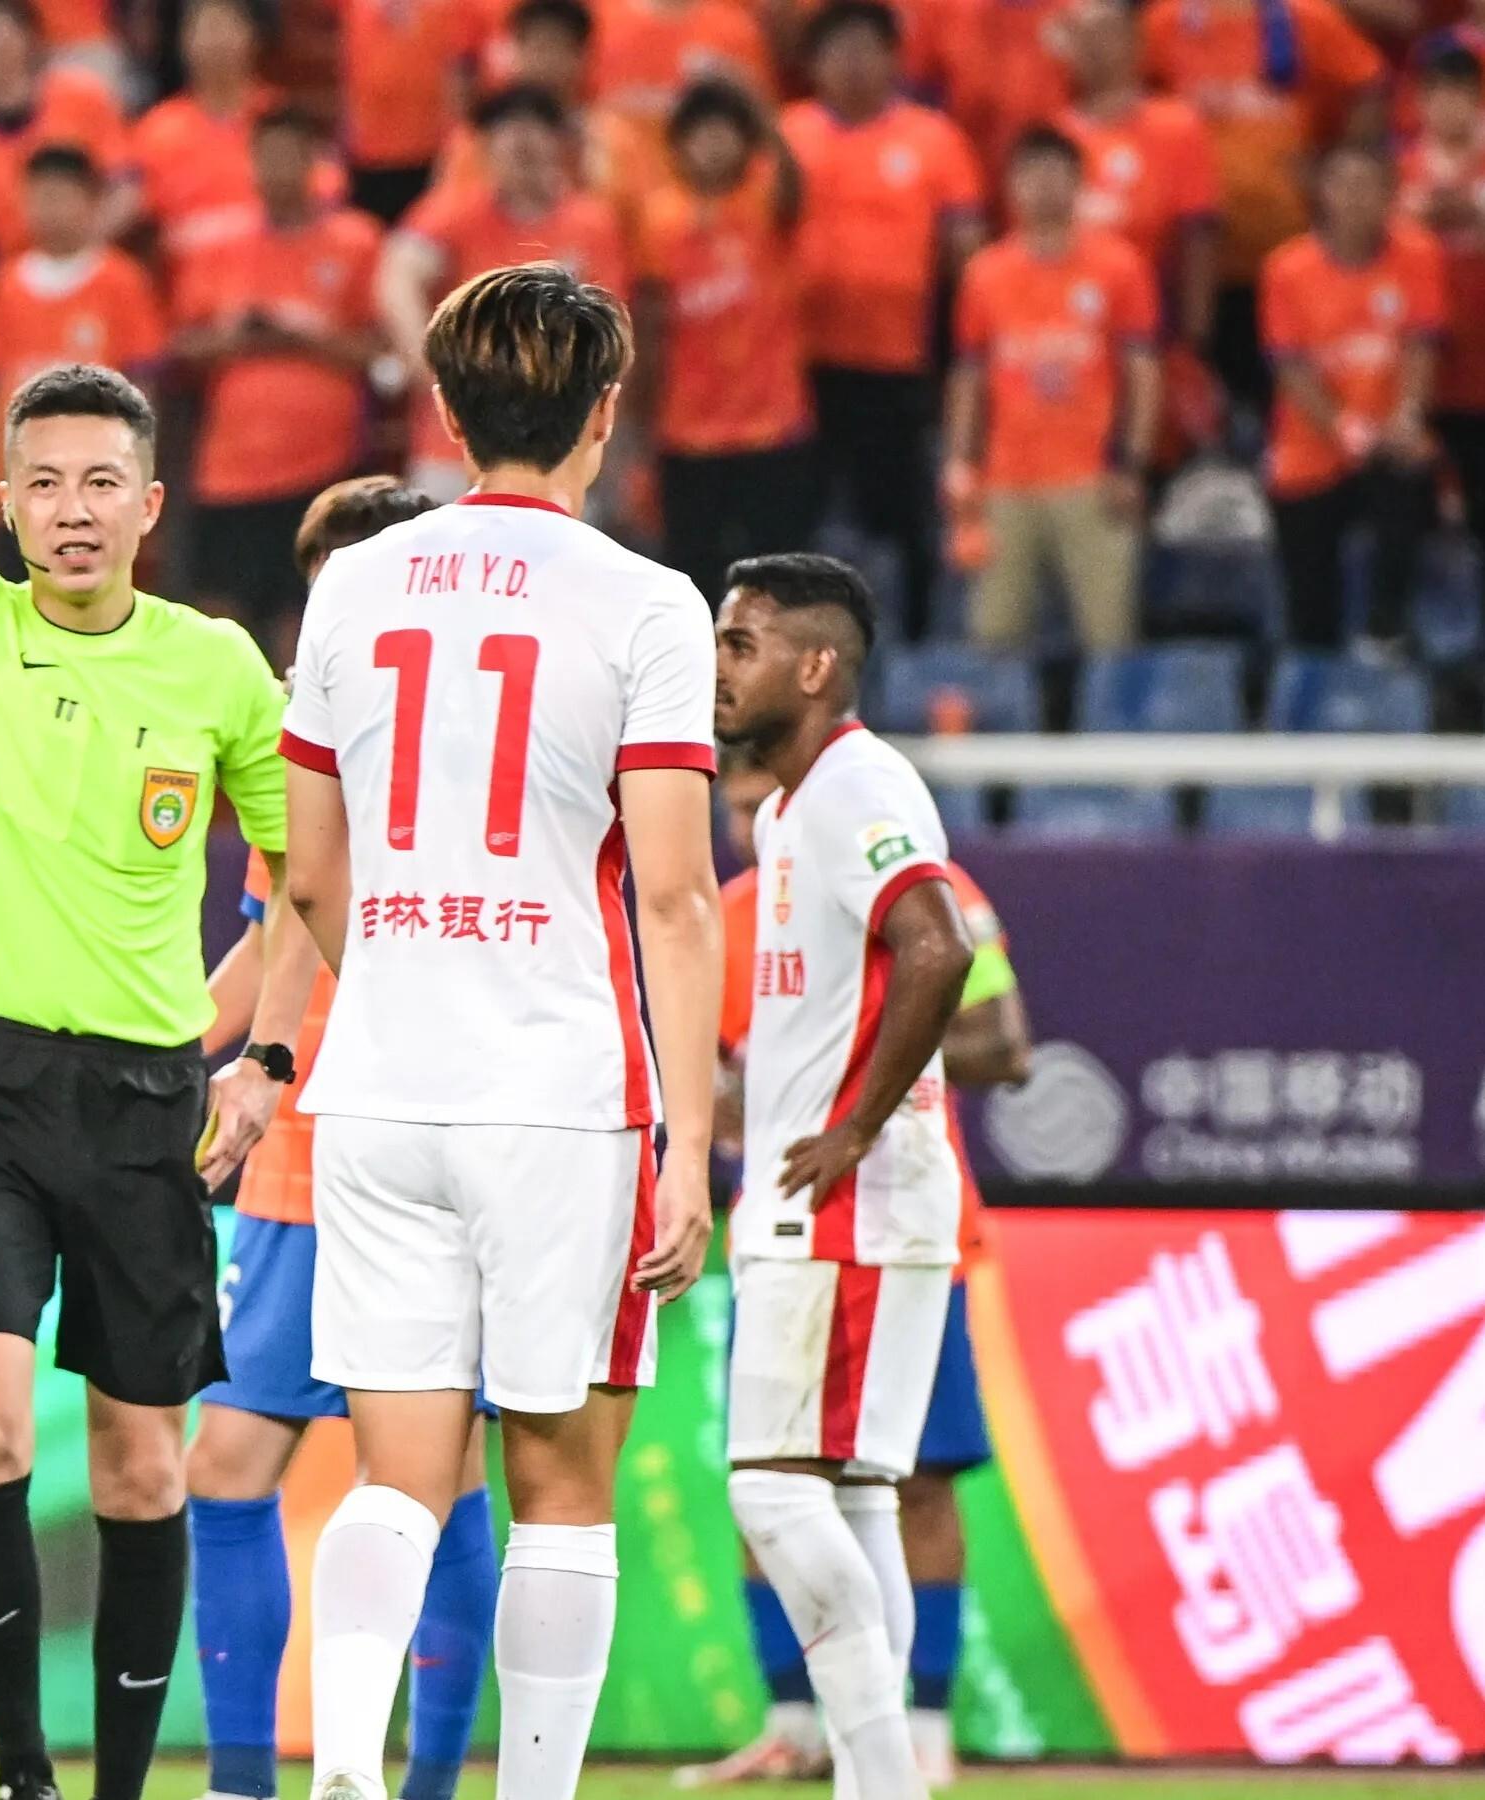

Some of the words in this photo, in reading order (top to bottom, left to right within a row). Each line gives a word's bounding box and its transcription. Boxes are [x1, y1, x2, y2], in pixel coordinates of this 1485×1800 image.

[406, 552, 466, 596] TIAN
[480, 552, 529, 600] Y.D.
[373, 627, 540, 859] 11
